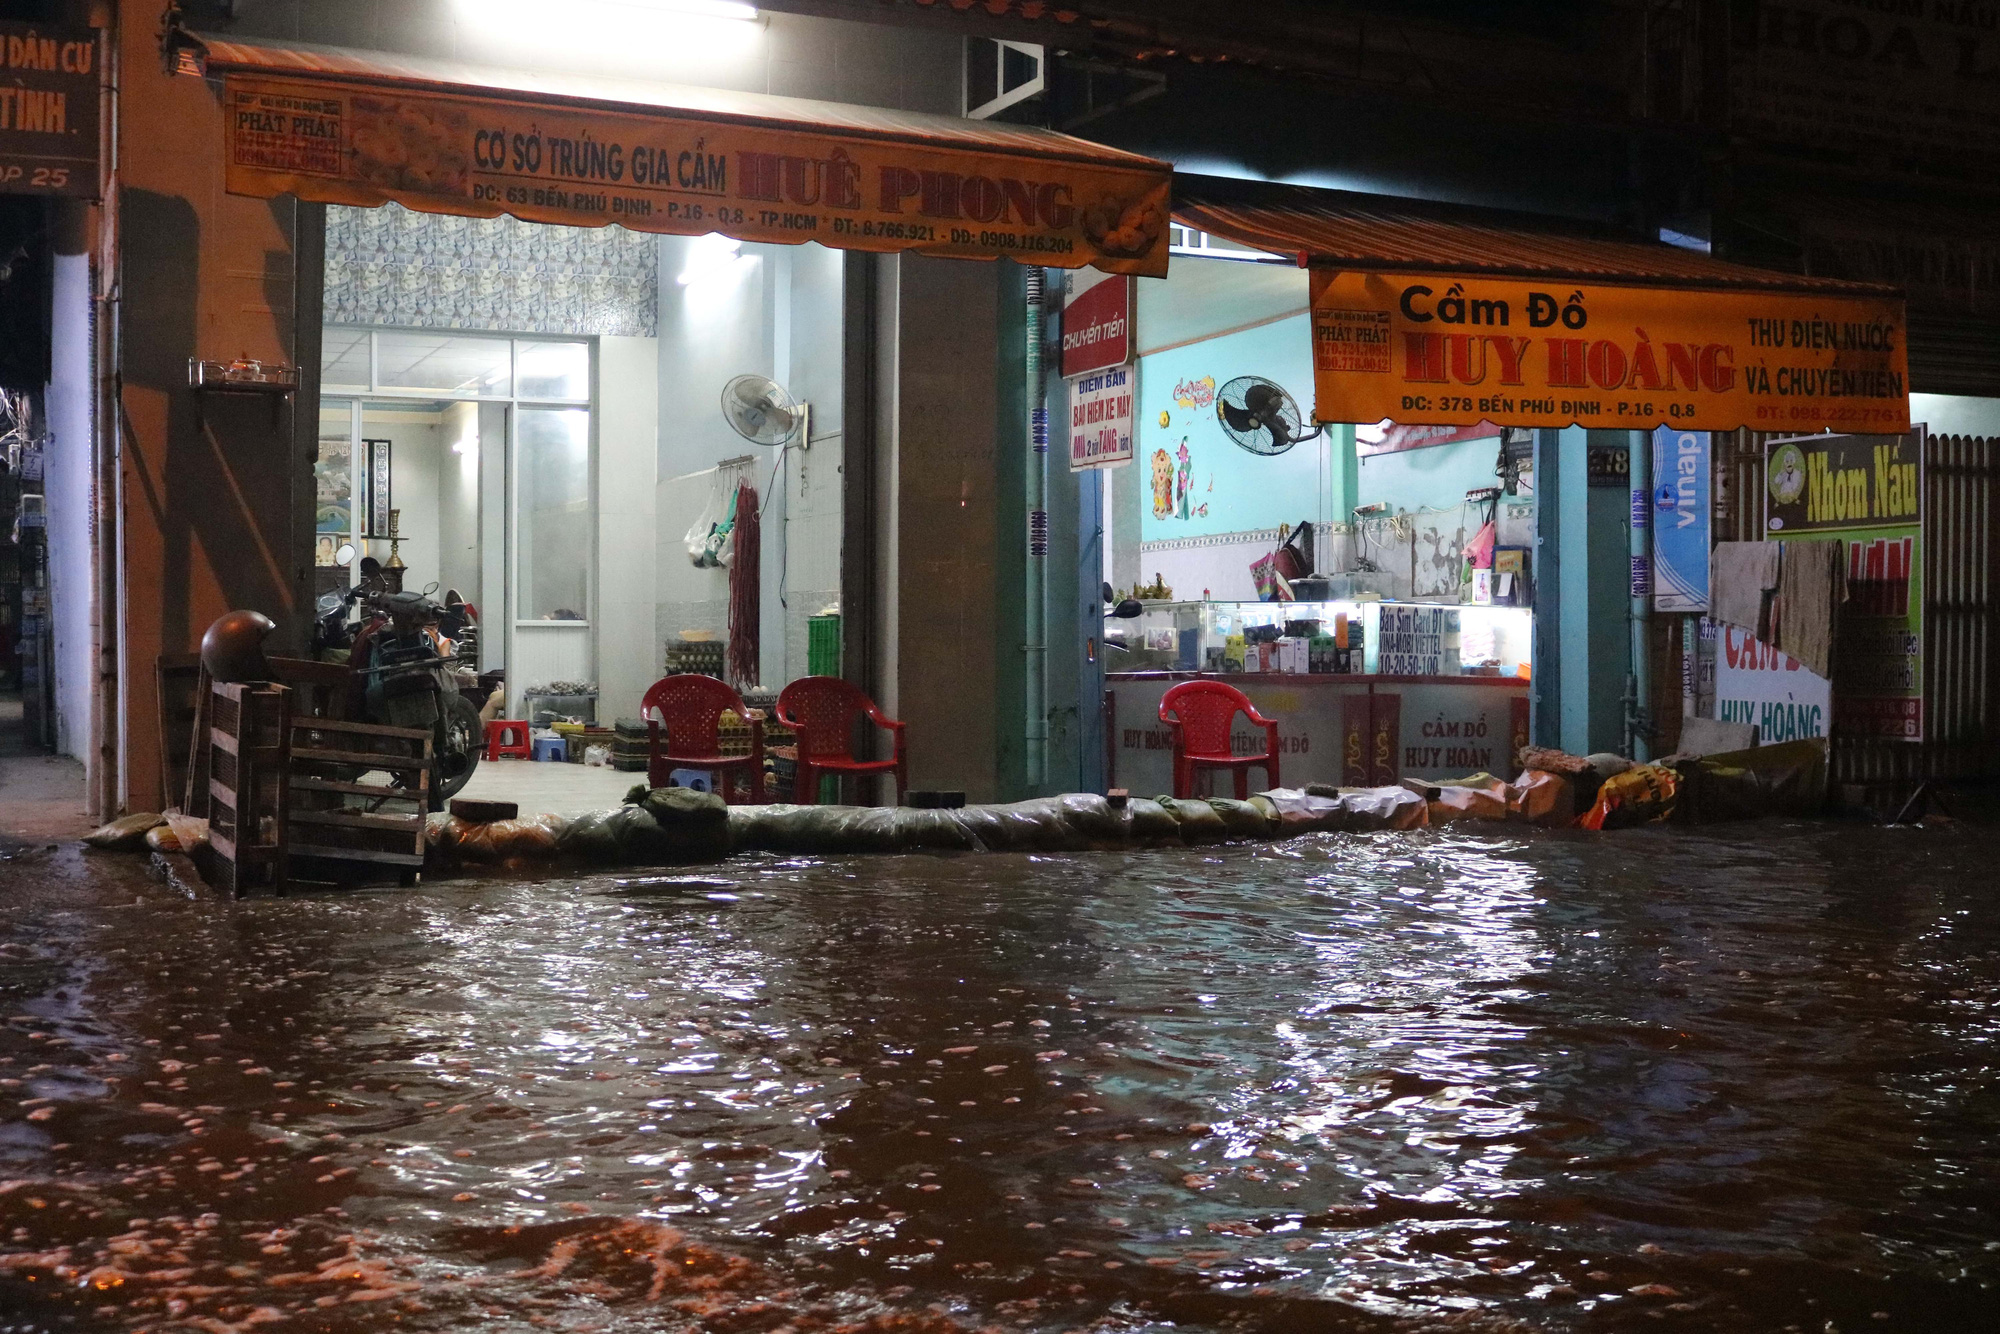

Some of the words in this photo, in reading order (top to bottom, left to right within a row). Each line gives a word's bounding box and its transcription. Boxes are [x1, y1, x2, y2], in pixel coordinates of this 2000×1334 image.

[8, 30, 57, 71] DÂN
[62, 39, 95, 75] CƯ
[31, 167, 70, 188] 25
[474, 127, 507, 169] CƠ
[512, 124, 544, 173] SỞ
[548, 129, 624, 182] TRỨNG
[631, 145, 671, 186] GIA
[734, 146, 862, 211] HUÊ
[876, 165, 1076, 230] PHONG
[474, 183, 501, 203] ĐC:
[506, 187, 528, 204] 63
[533, 185, 569, 209] BẾN
[573, 191, 607, 212] PHÚ
[611, 196, 651, 218] ĐỊNH
[668, 201, 702, 220] P.16
[718, 206, 744, 226] Q.8
[759, 210, 817, 231] TP.HCM
[834, 218, 859, 234] ĐT:
[862, 220, 935, 242] 8.766.921
[980, 230, 1074, 254] 0908.116.204
[1400, 283, 1510, 326] Cầm
[1525, 290, 1588, 330] Đồ
[1318, 322, 1352, 341] PHÁT
[1356, 324, 1389, 343] PHÁT
[1748, 318, 1785, 347] THU
[1791, 313, 1837, 356] ĐIỆN
[1844, 316, 1895, 352] NƯỚC
[1401, 330, 1532, 387] HUY
[1543, 327, 1737, 394] HOÀNG
[1745, 357, 1771, 395] VÀ
[1079, 373, 1103, 394] ĐIỂM
[1087, 392, 1104, 424] HIỂM
[1105, 397, 1115, 421] XE
[1117, 391, 1131, 419] MÁY
[1402, 395, 1432, 411] ĐC:
[1439, 397, 1473, 412] 378
[1478, 393, 1514, 413] BẾN
[1519, 395, 1555, 414] PHÚ
[1560, 400, 1601, 418] ĐỊNH
[1617, 402, 1654, 417] P.16
[1669, 403, 1695, 418] Q.8
[1806, 451, 1869, 522] Nhóm
[1873, 435, 1918, 518] Nấu
[1380, 606, 1394, 632] Bán
[1397, 607, 1411, 633] Sim
[1413, 607, 1431, 633] Card
[1415, 634, 1442, 655] VIETTEL
[1380, 654, 1439, 675] 10-20-50-100
[1761, 692, 1822, 742] HOÀNG
[1124, 729, 1142, 749] HUY
[1145, 725, 1173, 751] HOÀNG
[1258, 735, 1288, 754] CM
[1405, 747, 1441, 768] HUY
[1446, 741, 1492, 768] HOÀN
